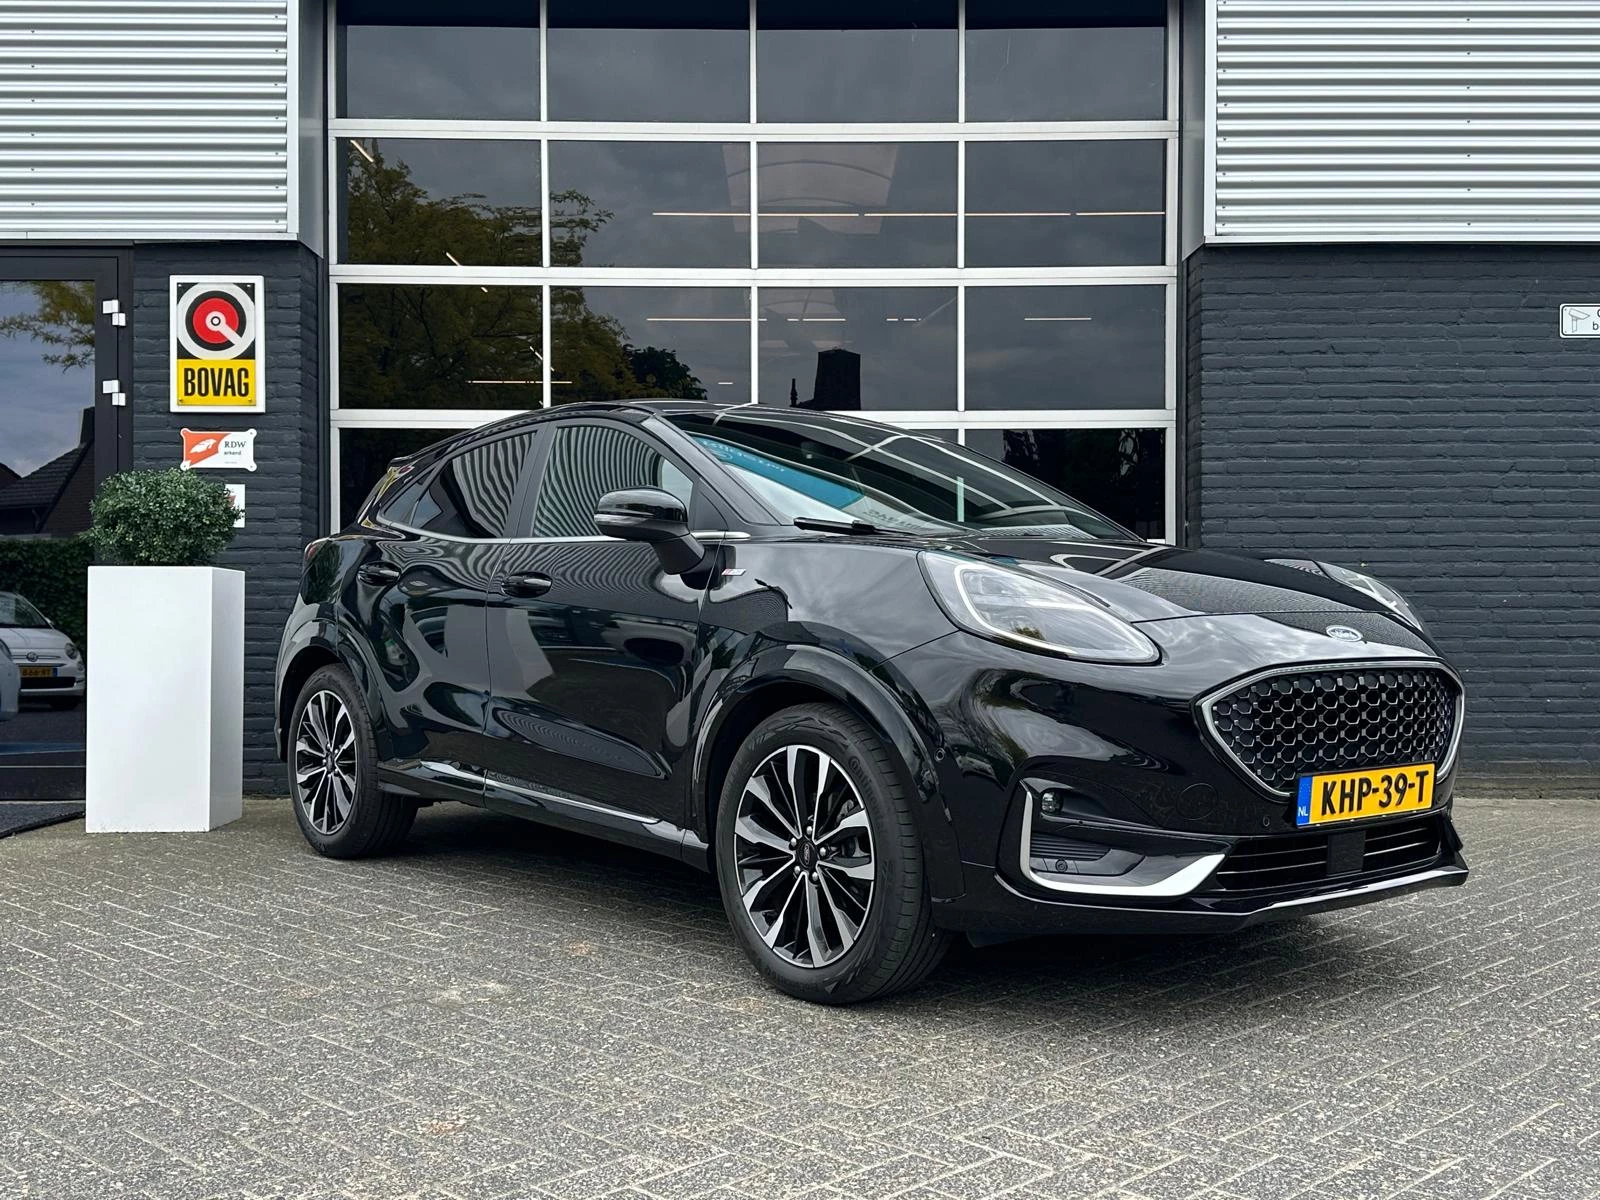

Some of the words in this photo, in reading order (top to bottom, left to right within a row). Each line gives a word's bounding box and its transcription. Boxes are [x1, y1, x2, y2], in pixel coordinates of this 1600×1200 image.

[183, 367, 249, 397] BOVAG
[224, 440, 246, 448] RDW
[1321, 770, 1429, 816] KHP-39-T
[1297, 806, 1309, 817] NL
